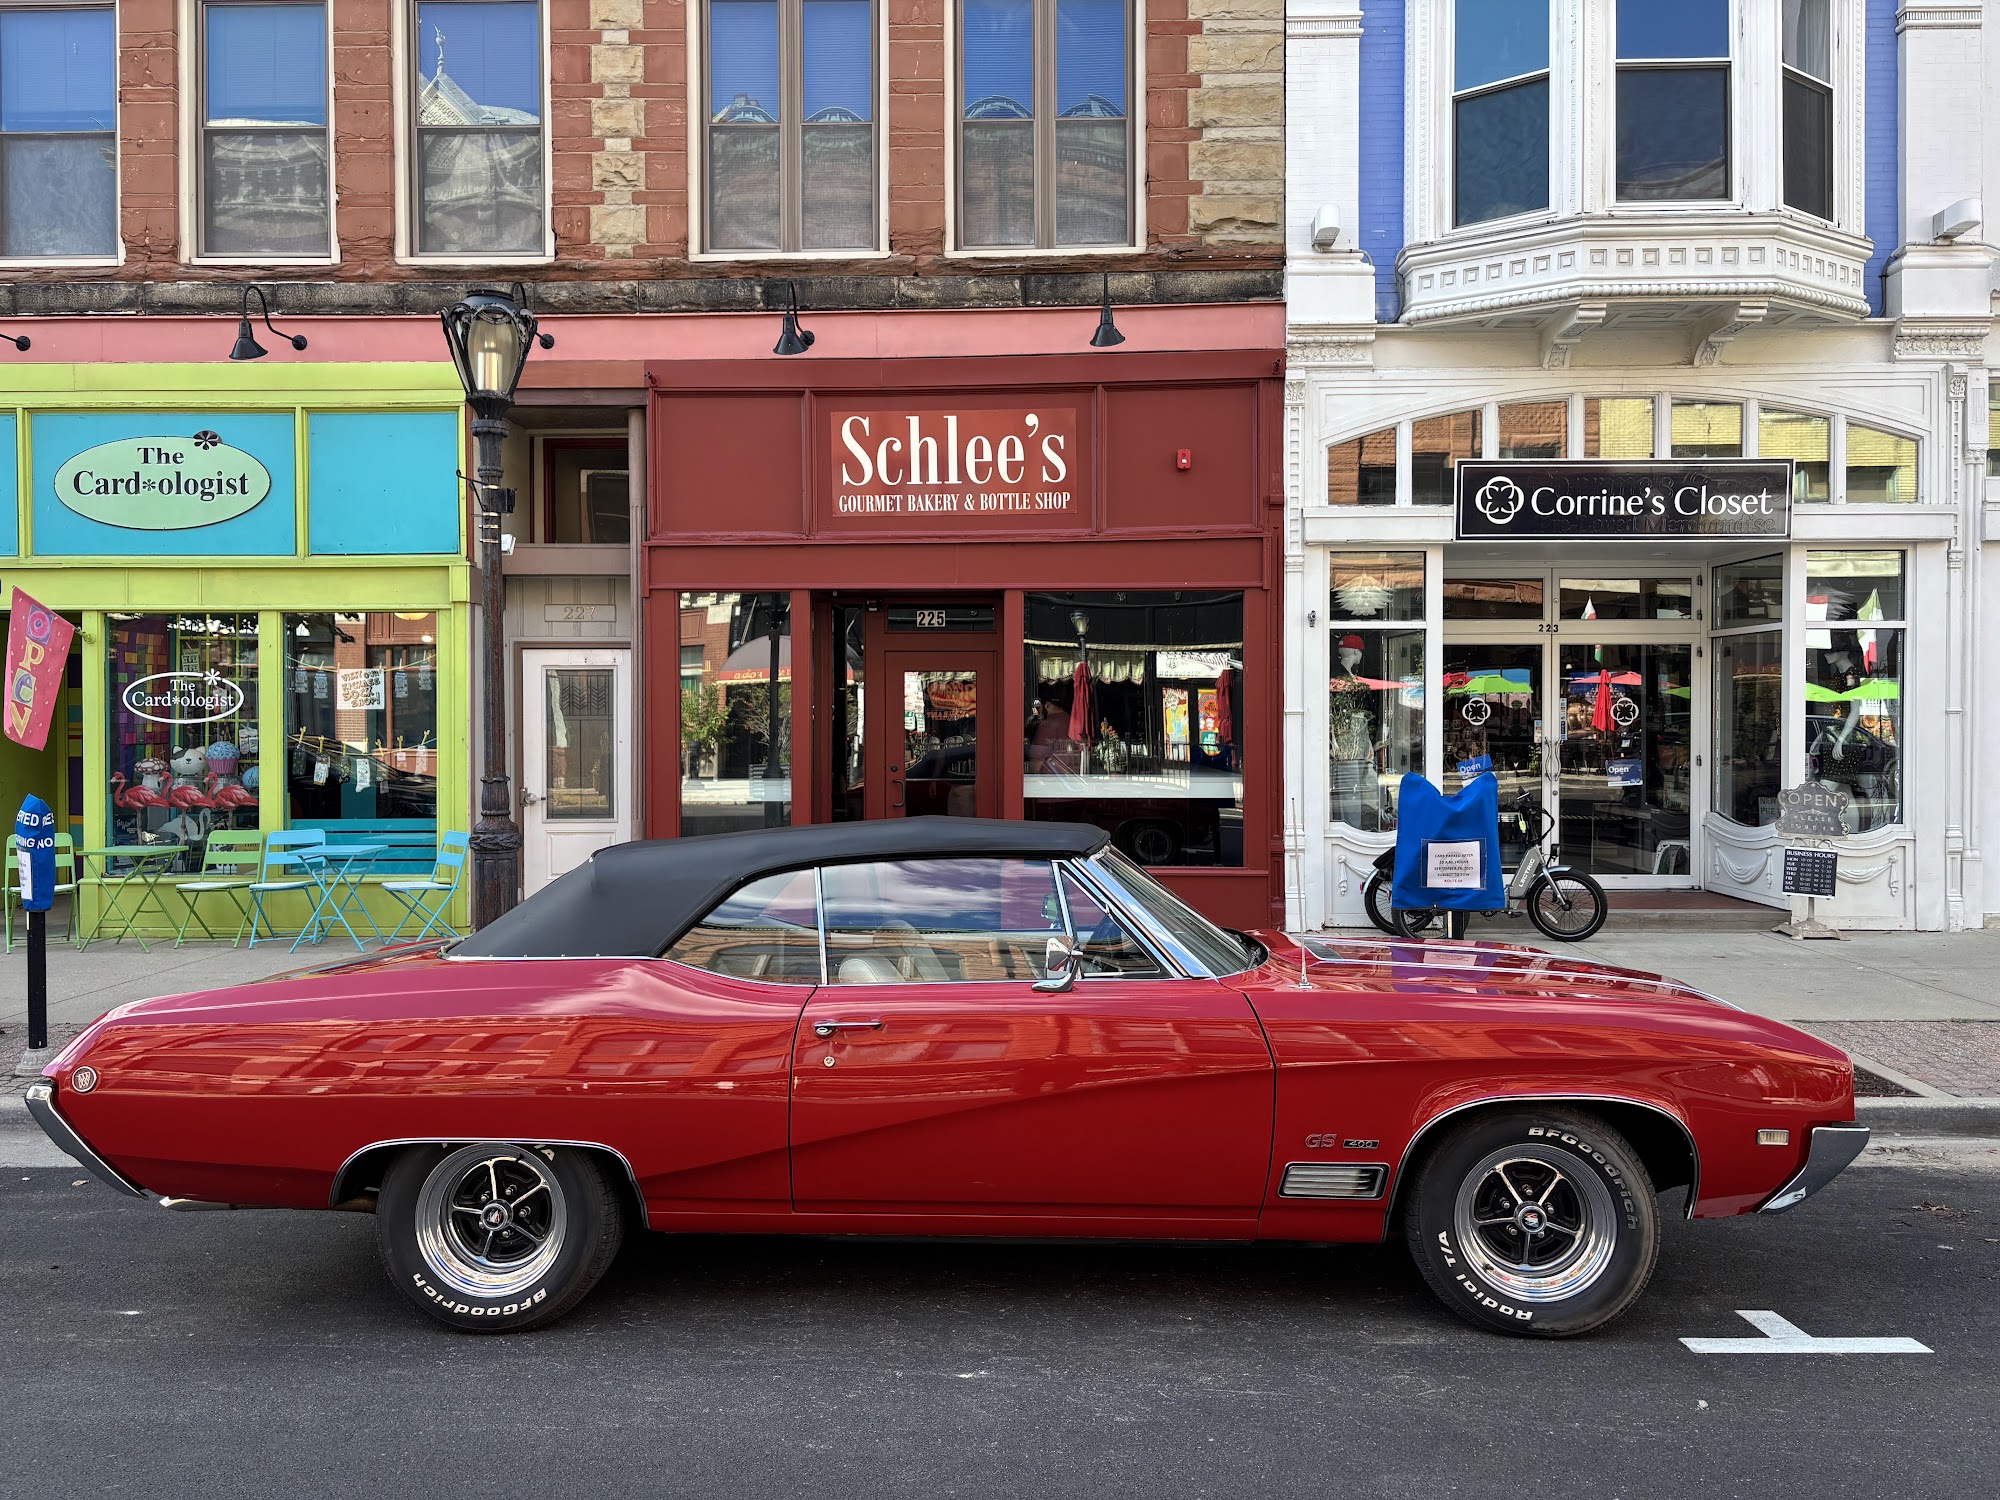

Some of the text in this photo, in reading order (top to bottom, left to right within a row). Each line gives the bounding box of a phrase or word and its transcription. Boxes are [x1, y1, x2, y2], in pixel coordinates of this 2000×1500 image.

[137, 447, 184, 464] The
[841, 413, 1067, 486] Schlee's
[839, 491, 1071, 513] GOURMET BAKERY & BOTTLE SHOP
[1531, 486, 1665, 516] Corrine's
[1674, 486, 1774, 516] Closet
[563, 606, 596, 620] 227
[918, 611, 944, 626] 225
[1538, 624, 1559, 633] 223
[170, 680, 195, 691] The
[1459, 762, 1481, 775] Open
[1608, 765, 1629, 775] Open
[1788, 792, 1837, 807] OPEN
[1305, 1133, 1373, 1148] GS 400
[1528, 1126, 1639, 1230] BFGoodrich
[1438, 1230, 1533, 1321] Radial T/A
[412, 1273, 547, 1316] BFGoodrich
